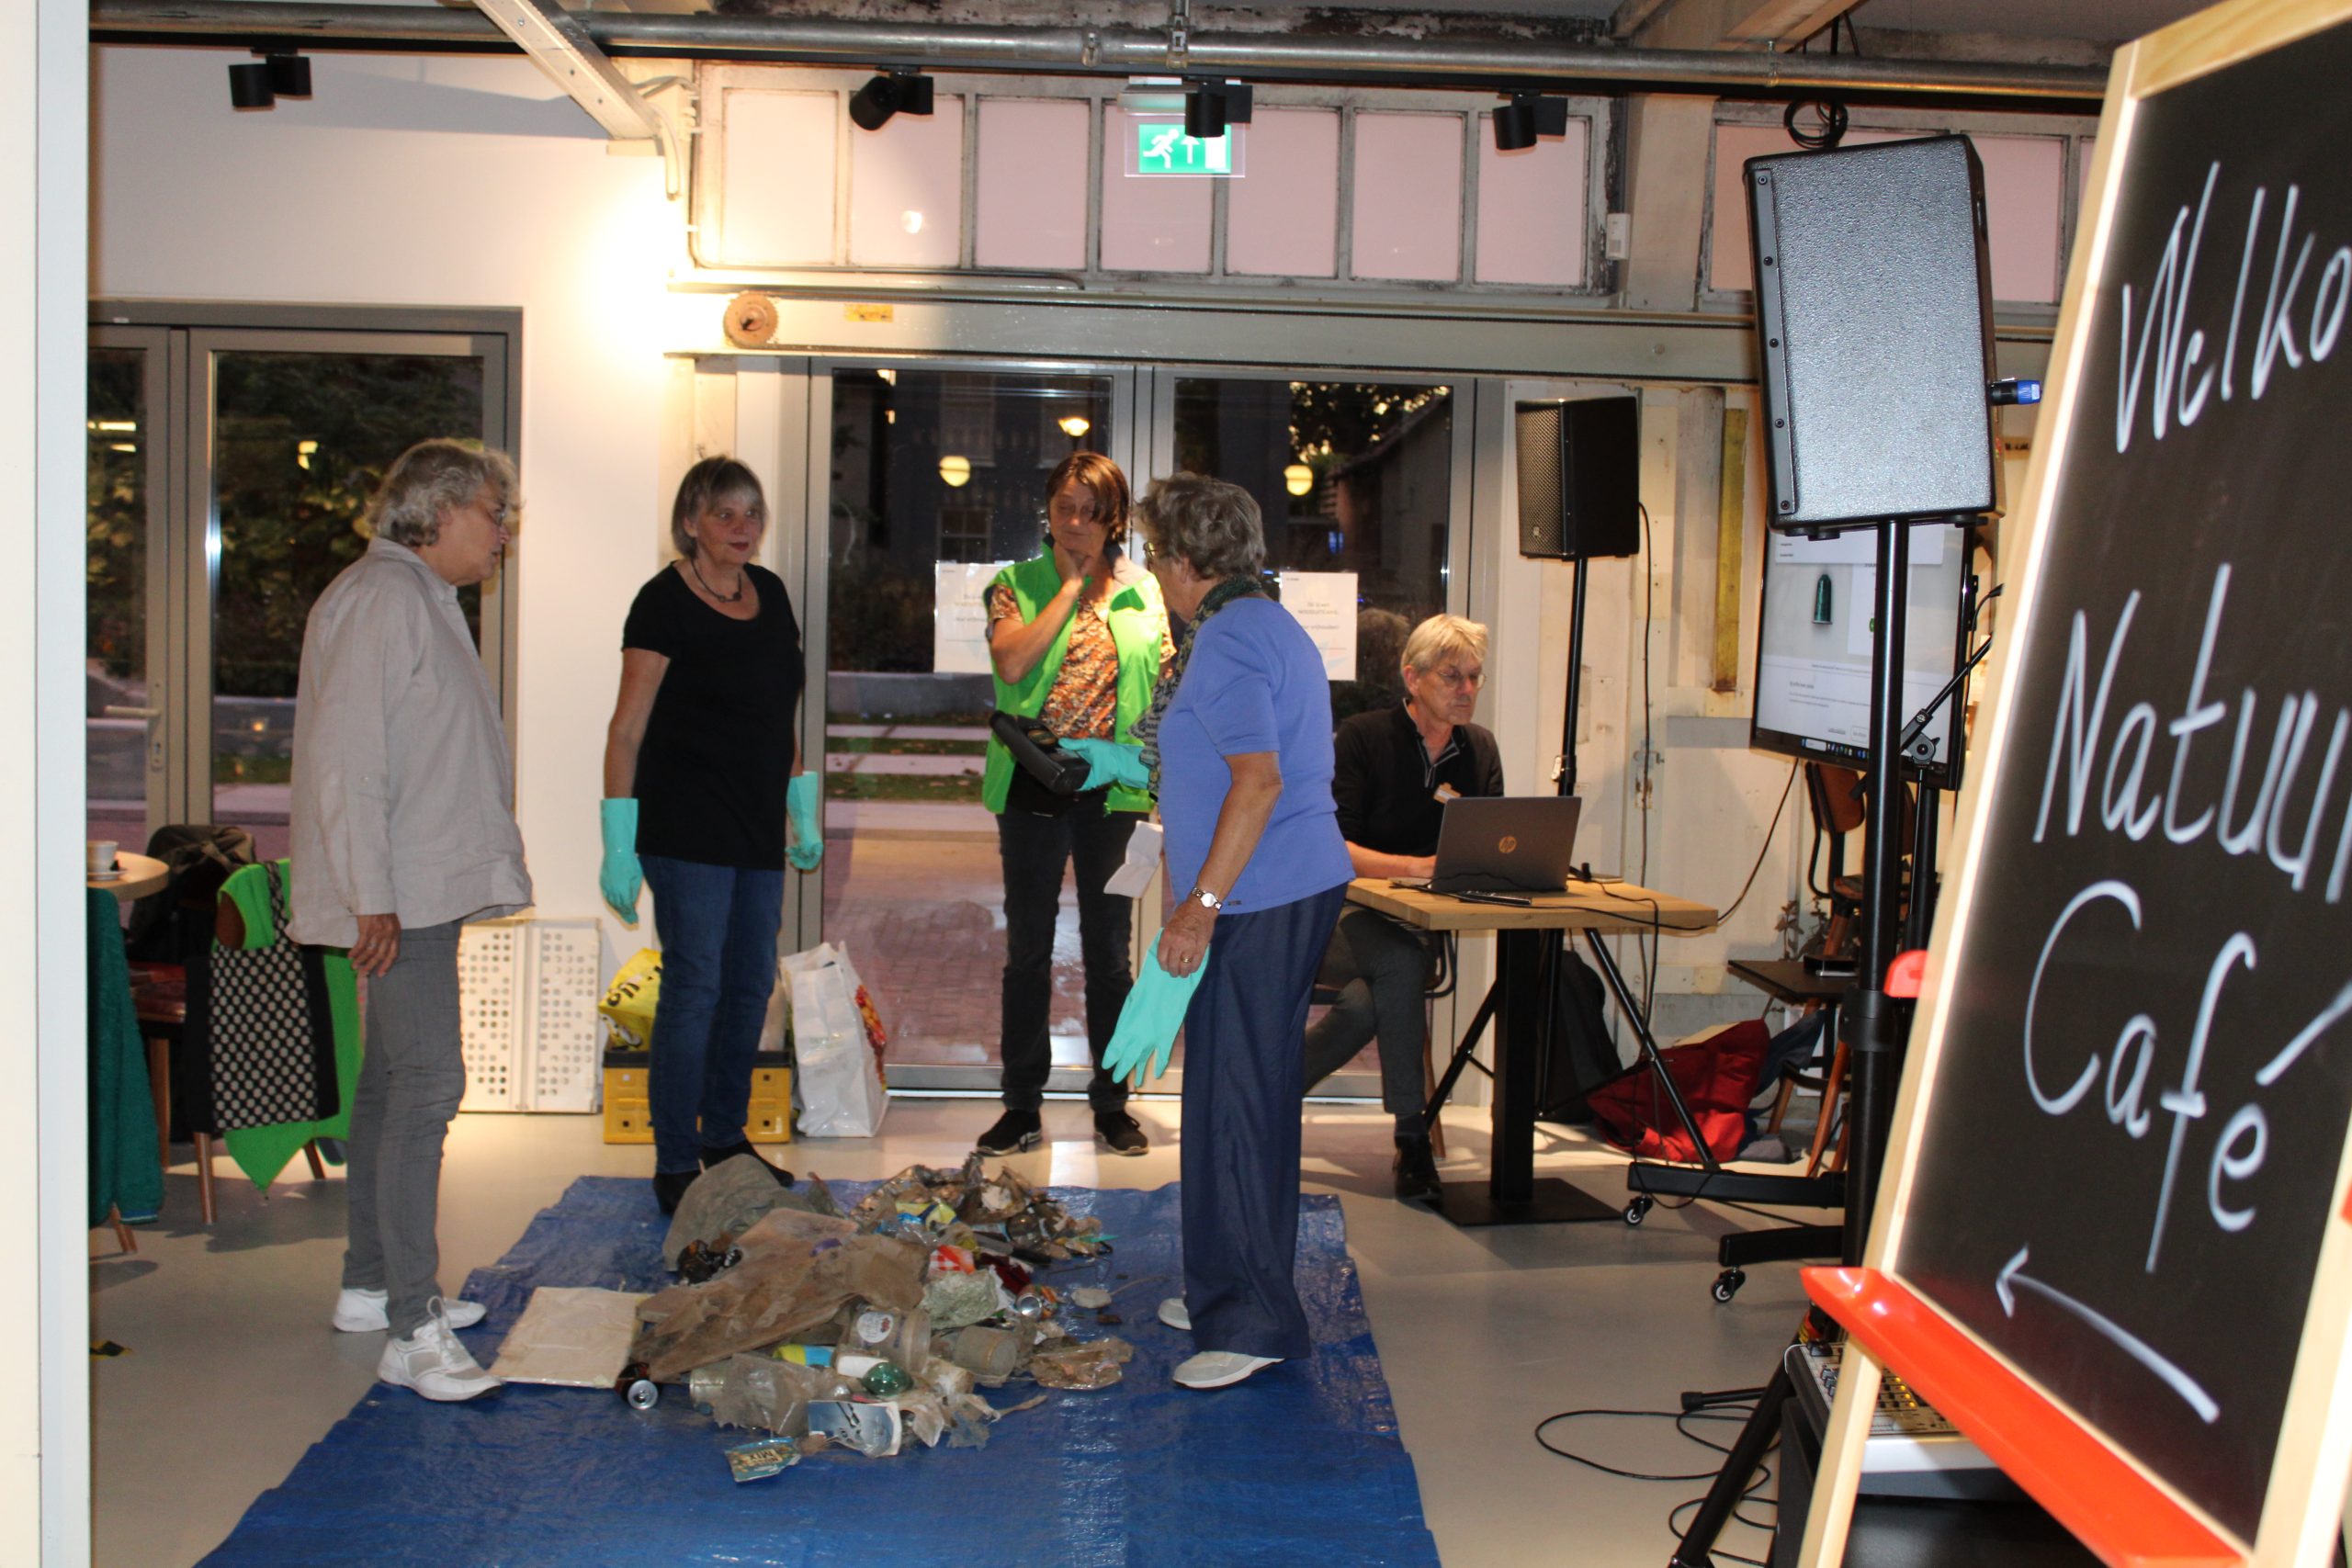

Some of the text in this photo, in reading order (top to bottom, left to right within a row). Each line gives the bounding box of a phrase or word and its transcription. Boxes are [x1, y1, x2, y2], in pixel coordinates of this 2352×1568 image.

[2116, 160, 2352, 454] Welko
[1498, 836, 1516, 853] hp
[2024, 880, 2352, 1274] Café
